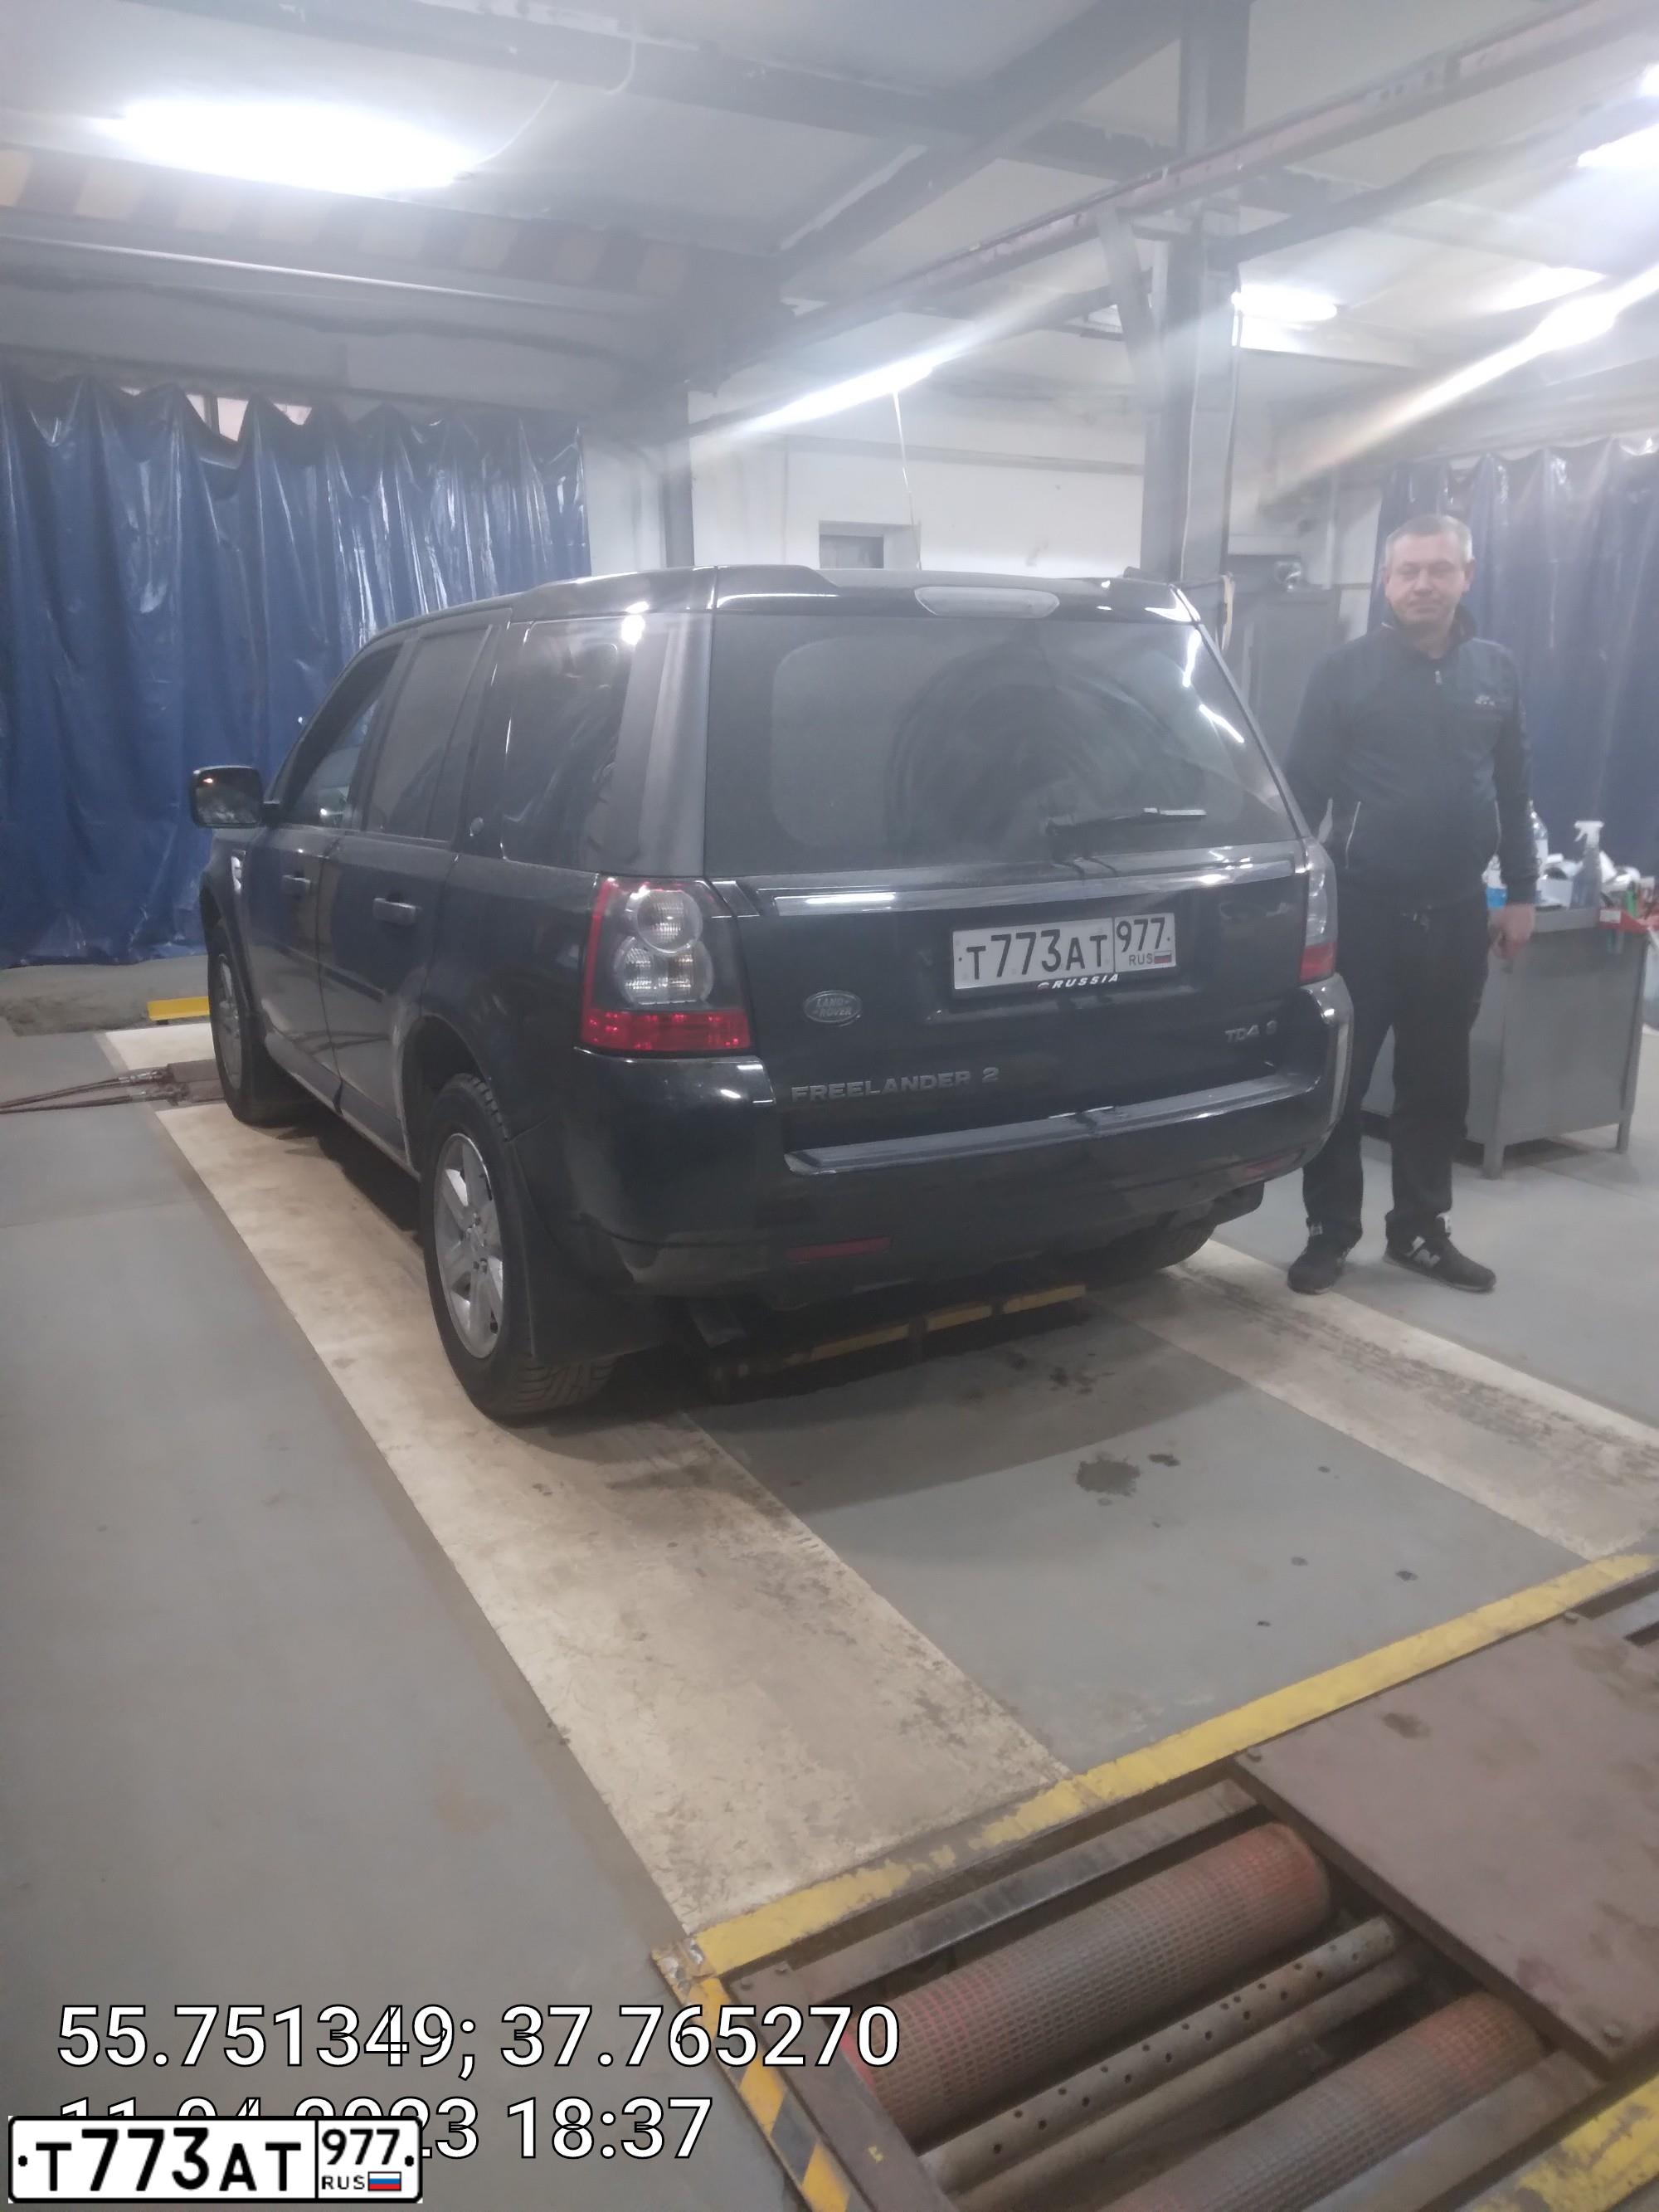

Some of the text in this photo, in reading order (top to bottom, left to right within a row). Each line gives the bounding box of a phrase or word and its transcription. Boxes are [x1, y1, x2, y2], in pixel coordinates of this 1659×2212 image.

[1116, 917, 1166, 953] 977
[1128, 952, 1153, 967] RUS
[1051, 972, 1120, 990] RUSSIA
[791, 1066, 1000, 1104] FREELANDER 2
